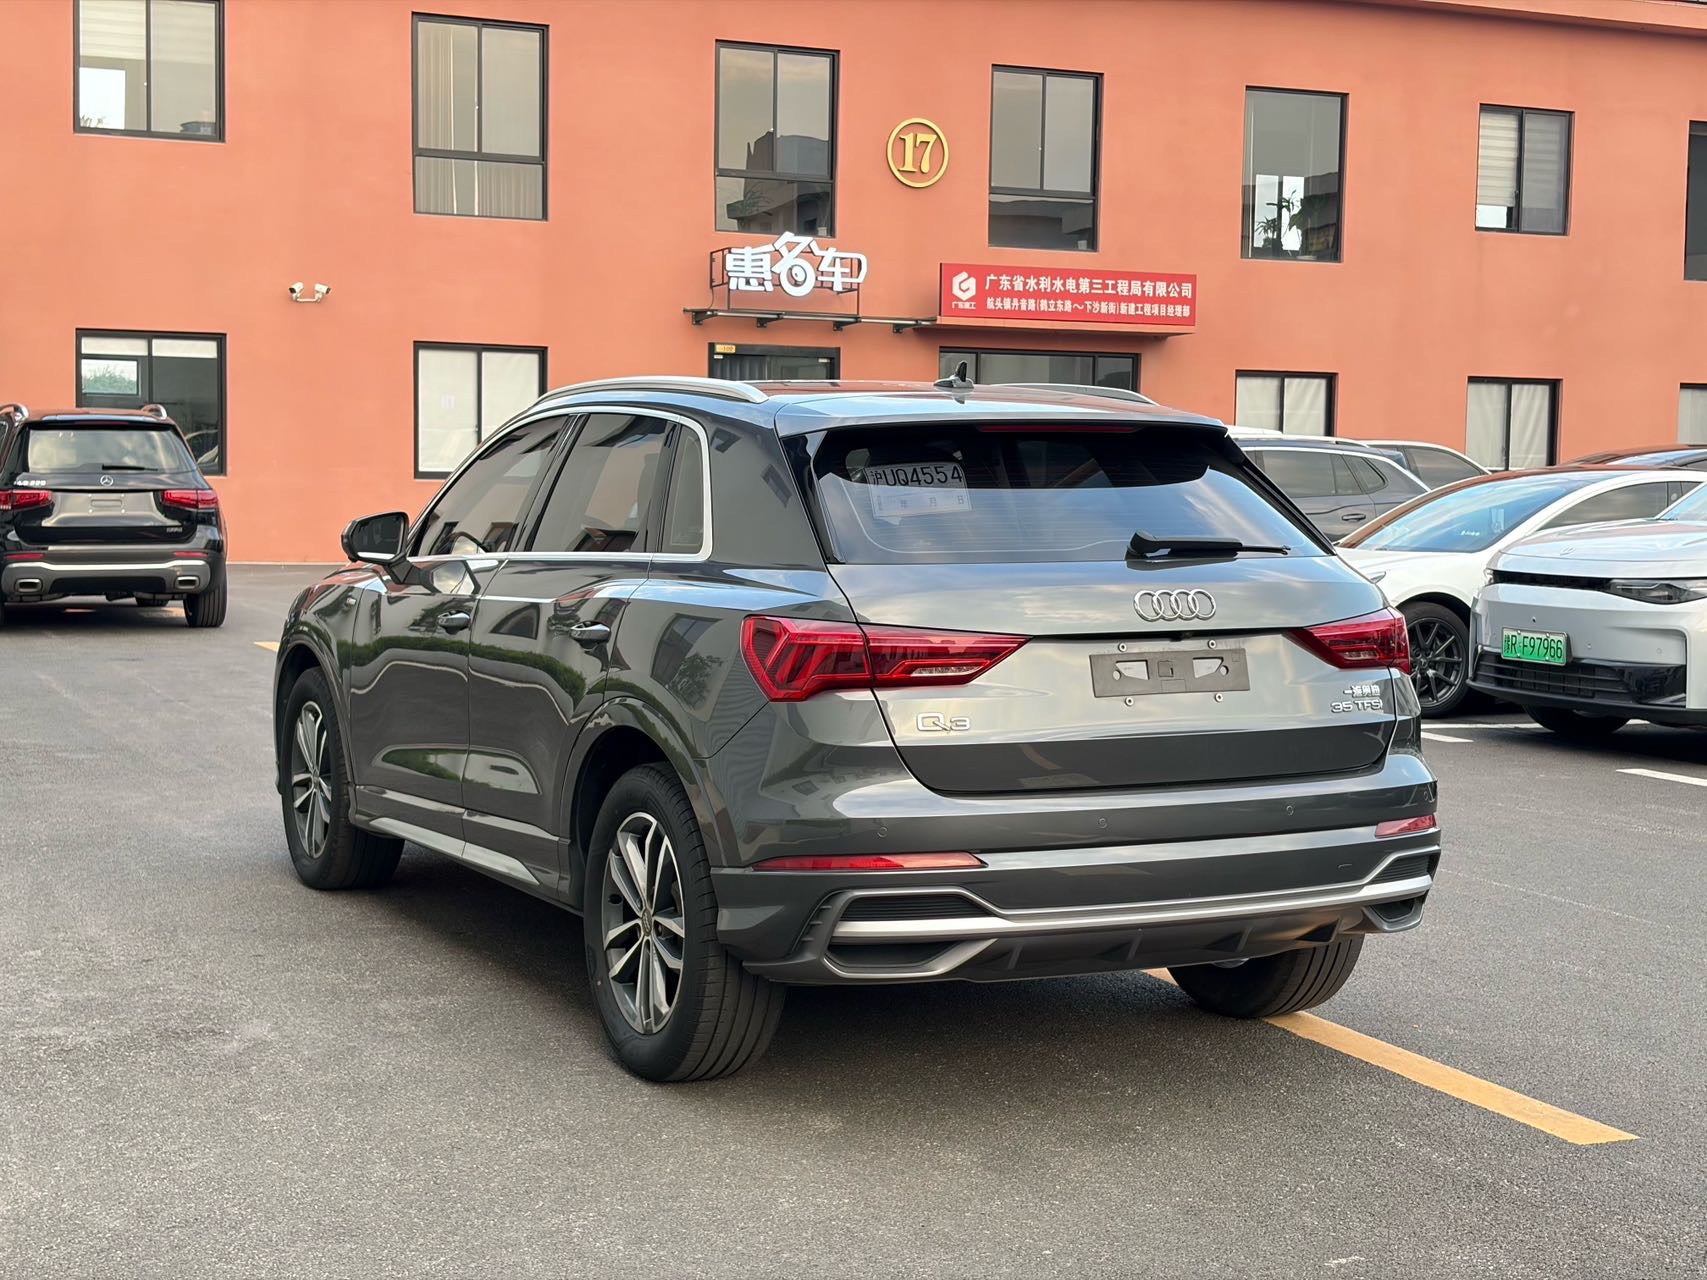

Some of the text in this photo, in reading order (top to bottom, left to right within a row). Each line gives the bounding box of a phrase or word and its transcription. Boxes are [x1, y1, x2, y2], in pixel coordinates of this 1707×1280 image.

[898, 132, 938, 174] 17
[984, 273, 1193, 299] 广东省水利水电第三工程局有限公司
[1331, 699, 1383, 713] 35 TFSI
[916, 711, 971, 732] Q3
